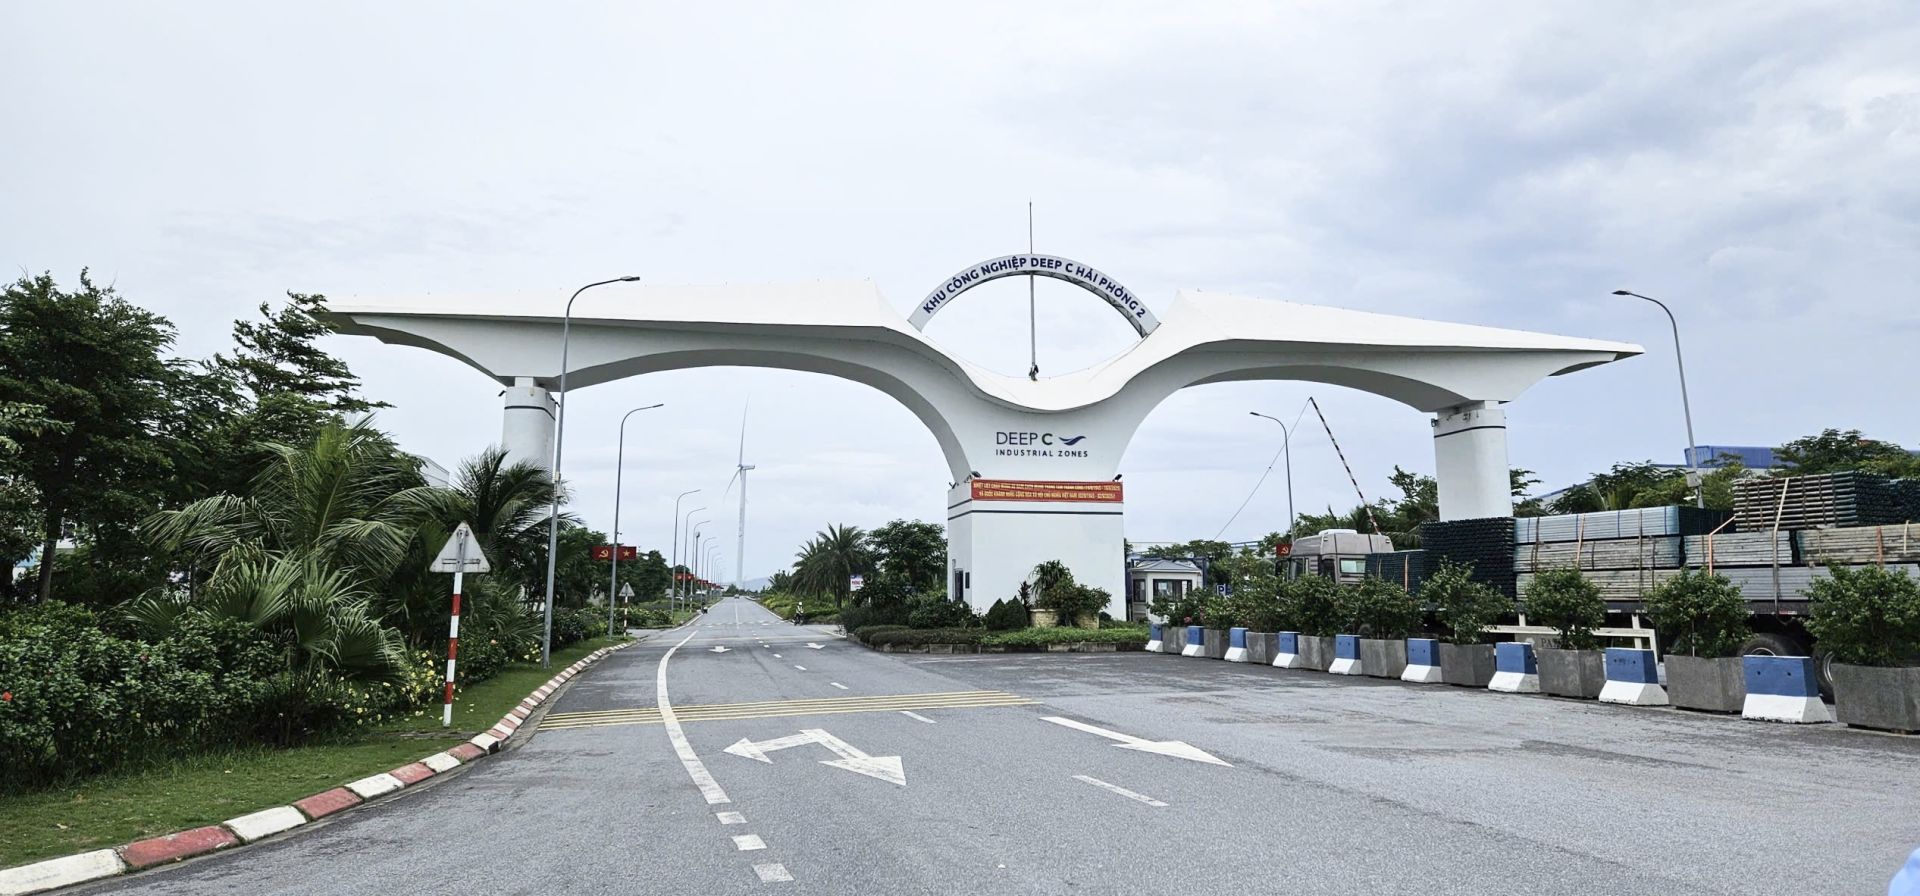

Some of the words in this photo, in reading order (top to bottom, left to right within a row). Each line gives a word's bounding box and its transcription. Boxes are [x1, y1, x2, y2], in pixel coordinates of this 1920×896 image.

[923, 290, 946, 314] KHU
[946, 269, 980, 293] CÔNG
[980, 255, 1027, 276] NGHIỆP
[1030, 257, 1063, 270] DEEP
[1065, 263, 1074, 273] C
[1075, 267, 1099, 283] HẢI
[1098, 277, 1139, 310] PHÒNG
[1136, 308, 1146, 319] 2
[996, 431, 1038, 446] DEEP
[1041, 433, 1053, 446] C
[995, 449, 1054, 457] INDUSTRIAL
[1057, 450, 1088, 458] ZONES
